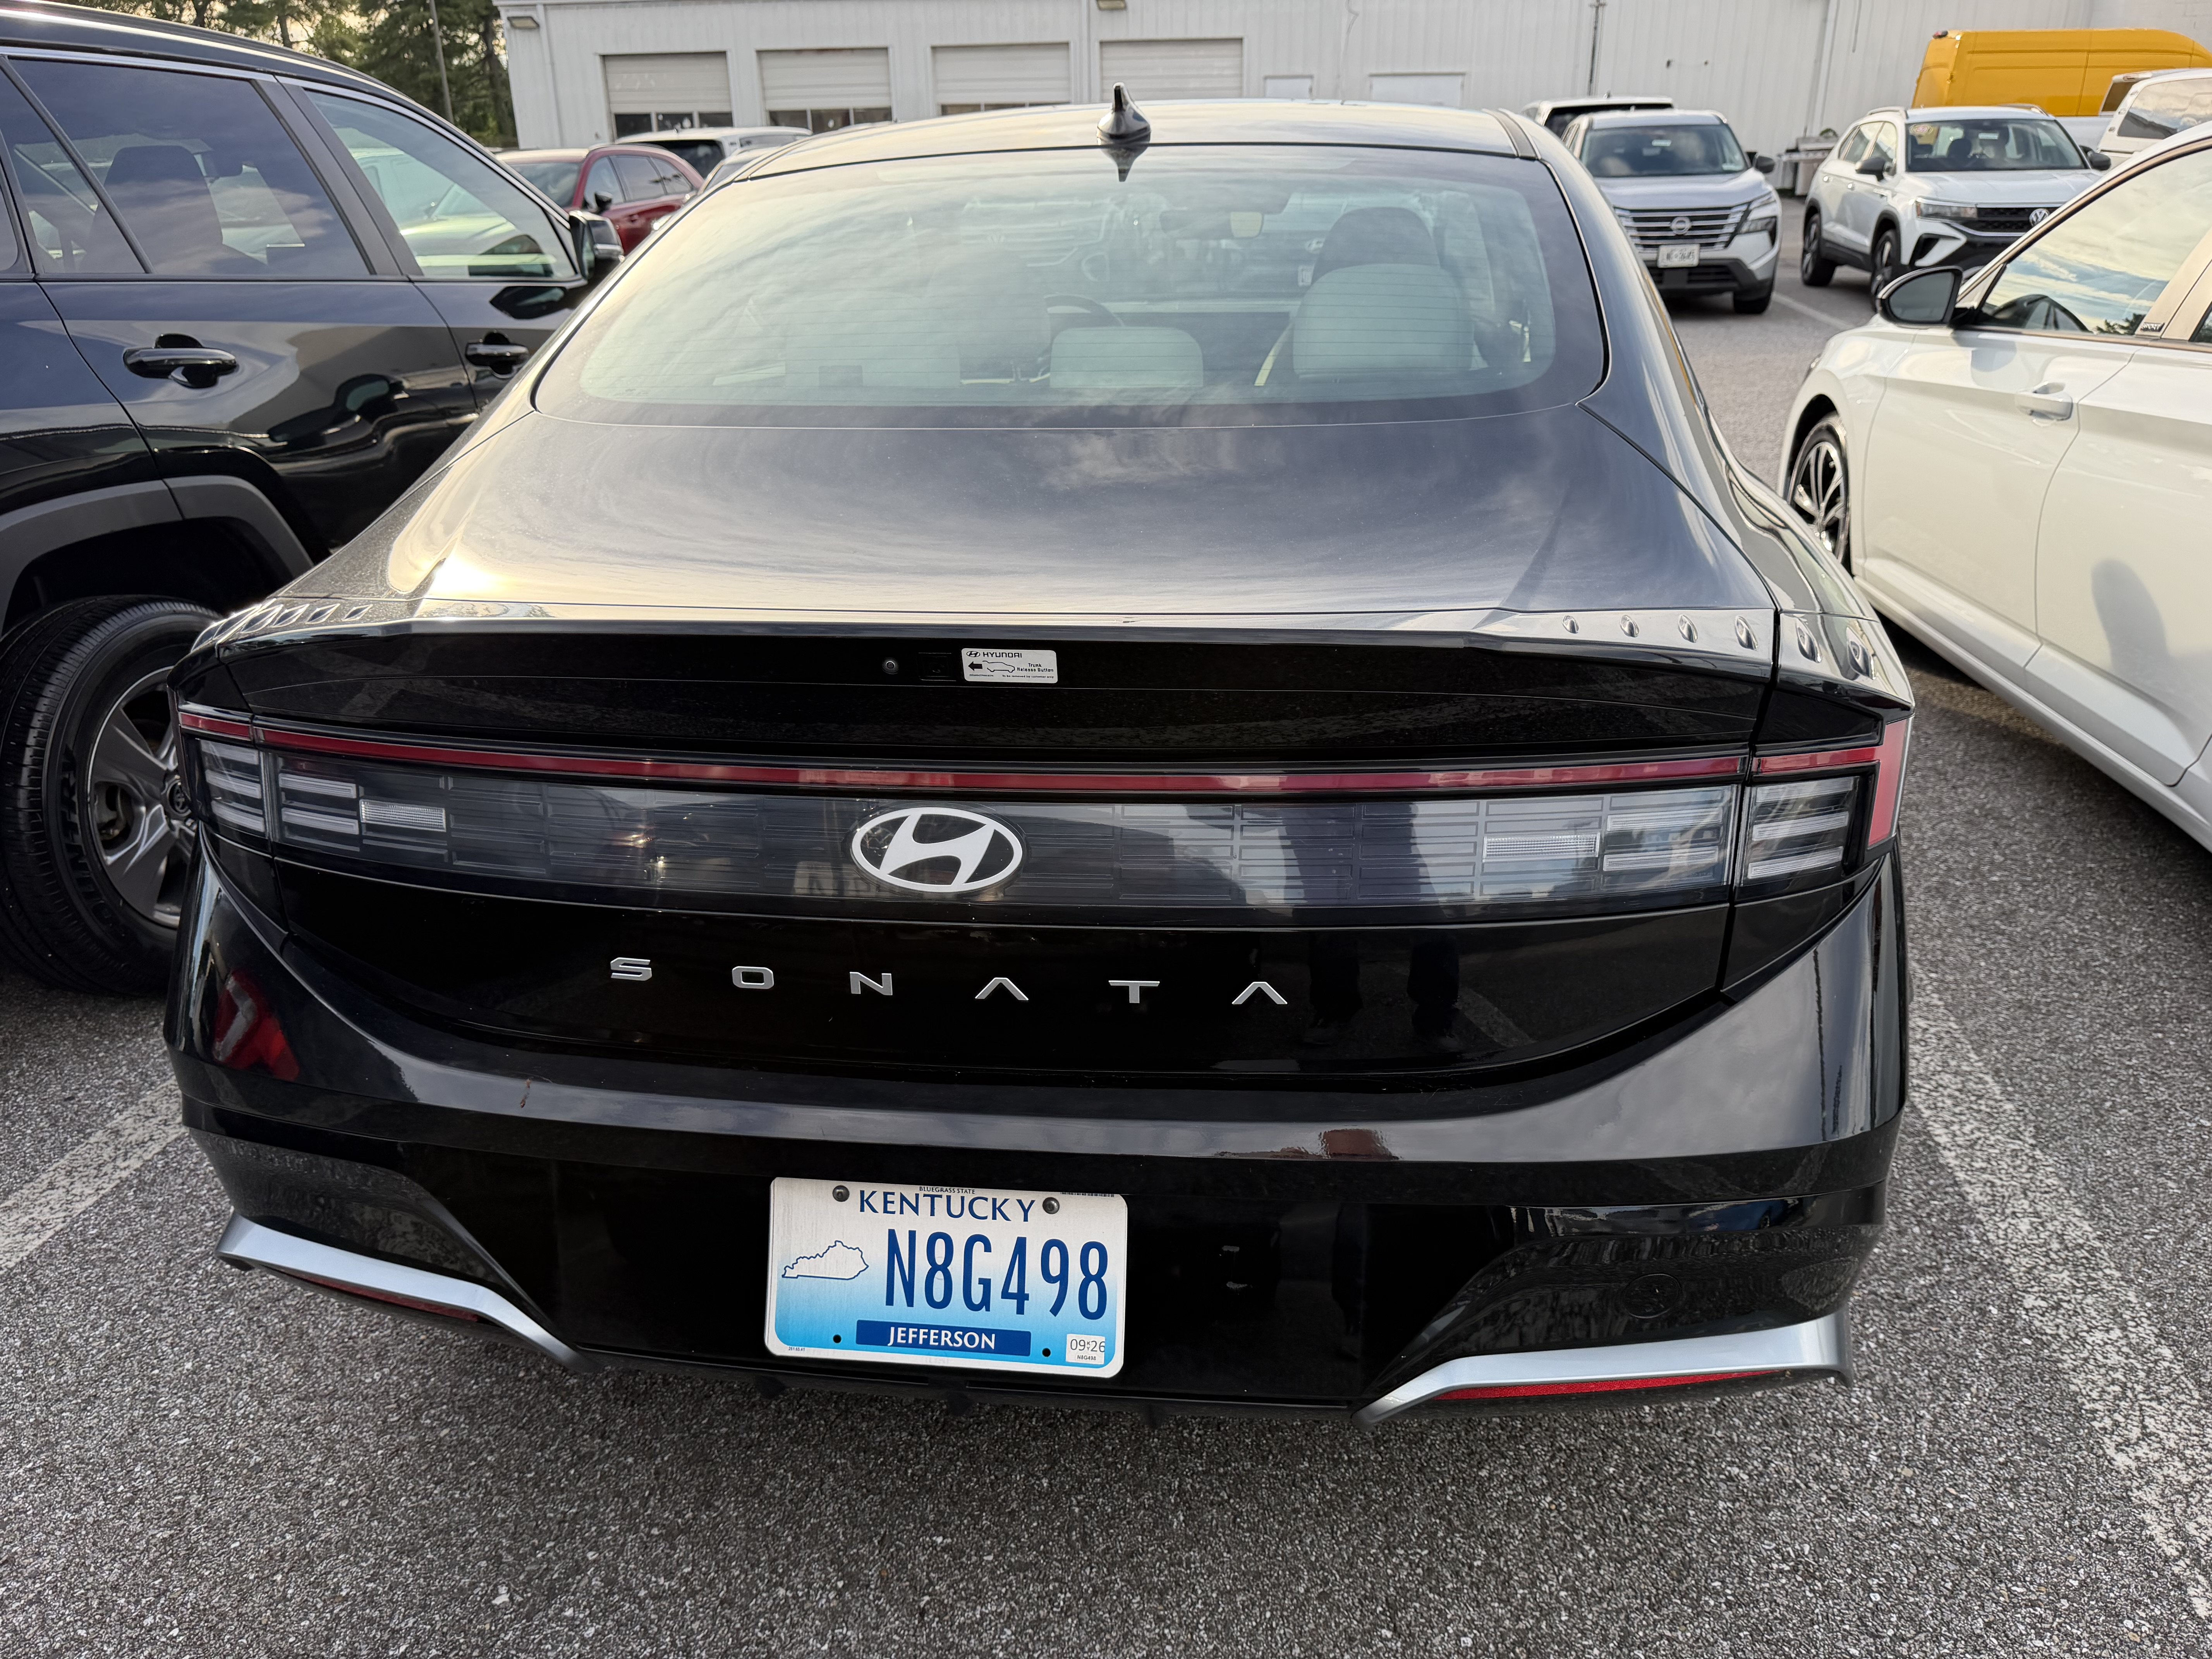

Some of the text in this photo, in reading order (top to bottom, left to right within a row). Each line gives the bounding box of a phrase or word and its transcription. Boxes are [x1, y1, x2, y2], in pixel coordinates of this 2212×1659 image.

[610, 957, 1288, 1005] SONATA
[859, 1190, 1036, 1222] KENTUCKY
[885, 1228, 1108, 1320] N8G498
[888, 1326, 996, 1350] JEFFERSON
